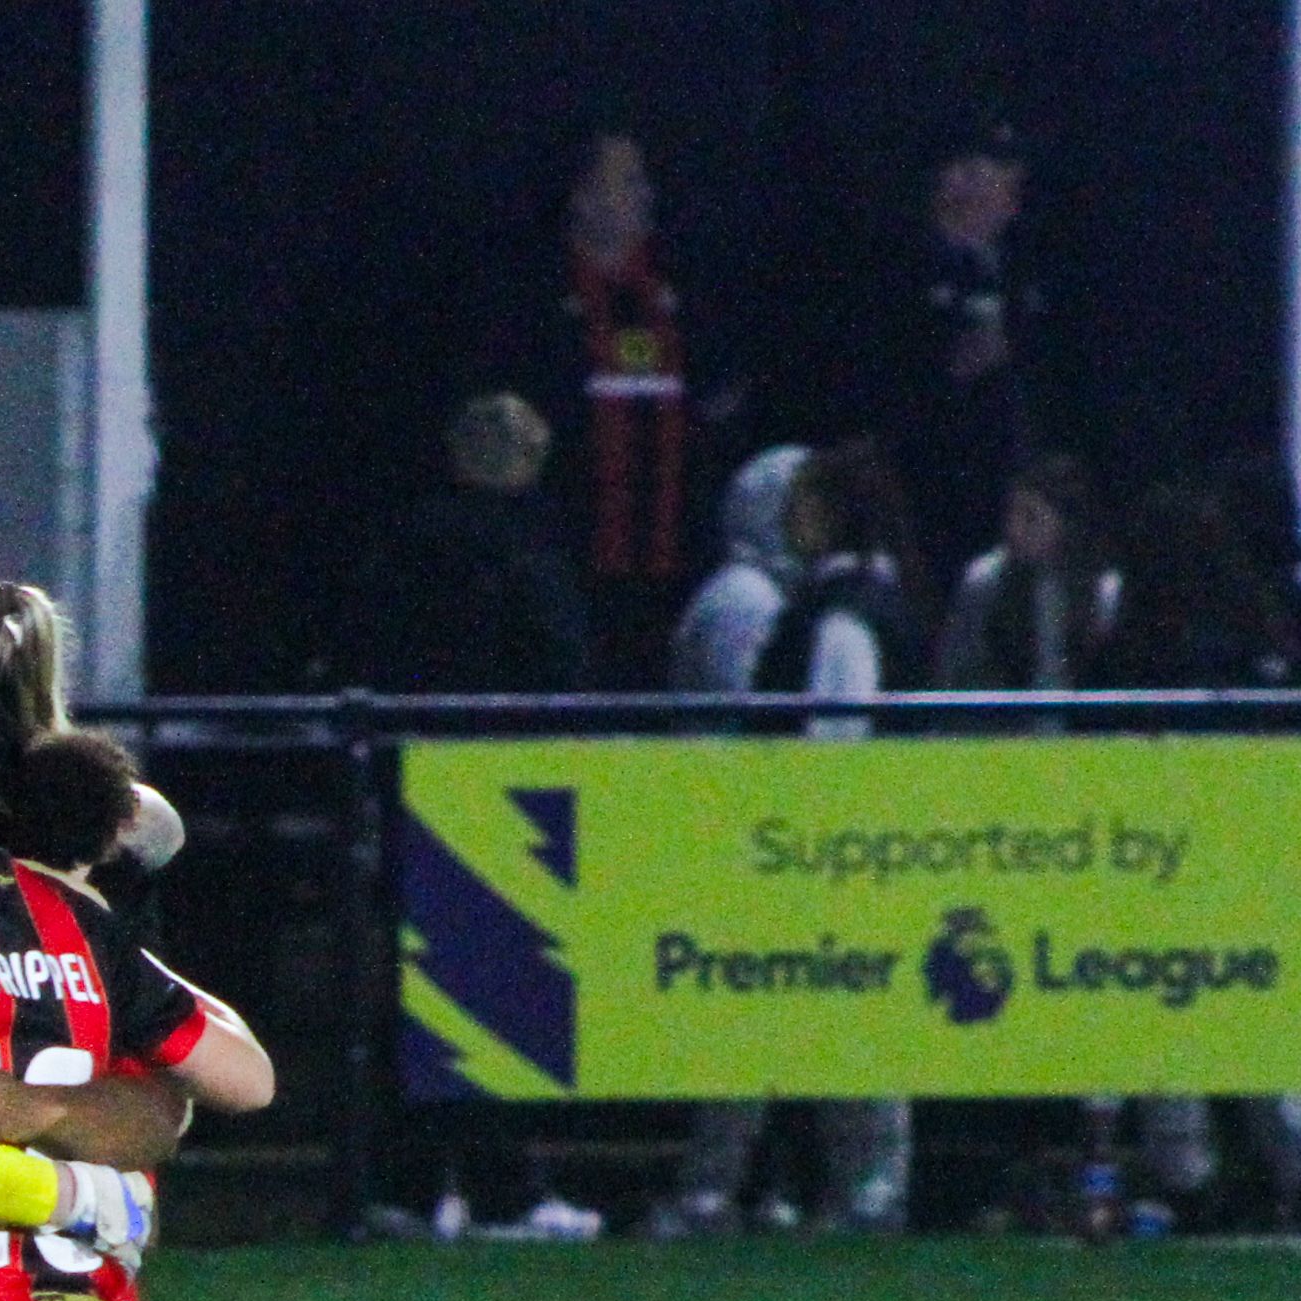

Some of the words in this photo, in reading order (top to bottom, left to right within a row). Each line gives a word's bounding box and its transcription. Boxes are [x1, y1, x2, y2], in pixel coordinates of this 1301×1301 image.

[751, 815, 1094, 884] Supported
[1109, 813, 1188, 886] by
[655, 930, 900, 991] Premier
[1034, 929, 1278, 1010] League
